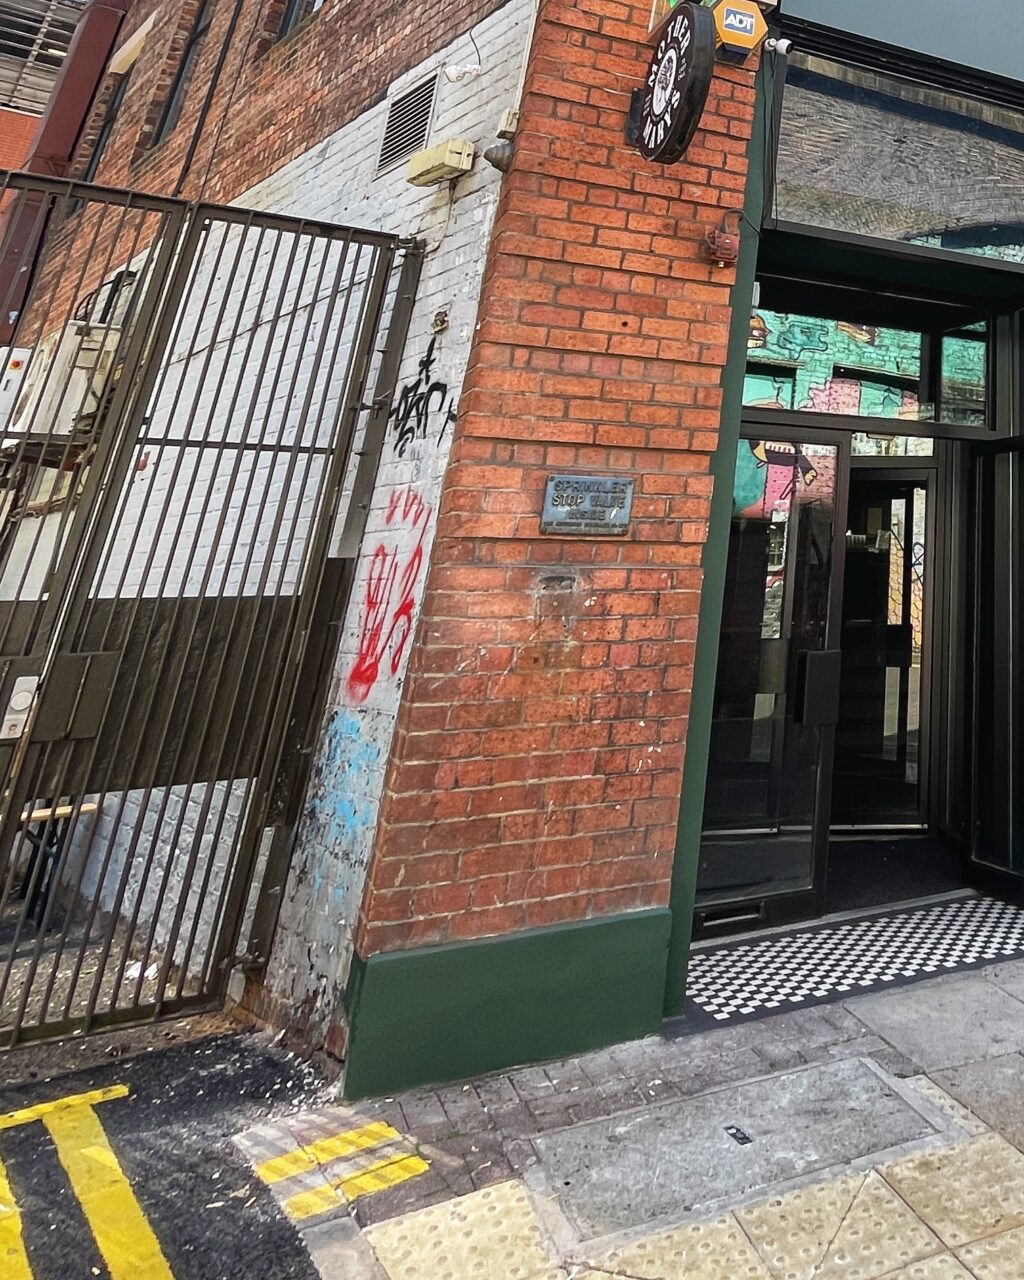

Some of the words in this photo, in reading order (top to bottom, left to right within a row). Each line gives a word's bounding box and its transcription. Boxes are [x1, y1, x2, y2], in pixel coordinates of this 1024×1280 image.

[725, 13, 754, 30] ADT
[648, 15, 690, 87] MOTHER
[553, 493, 585, 506] STOP
